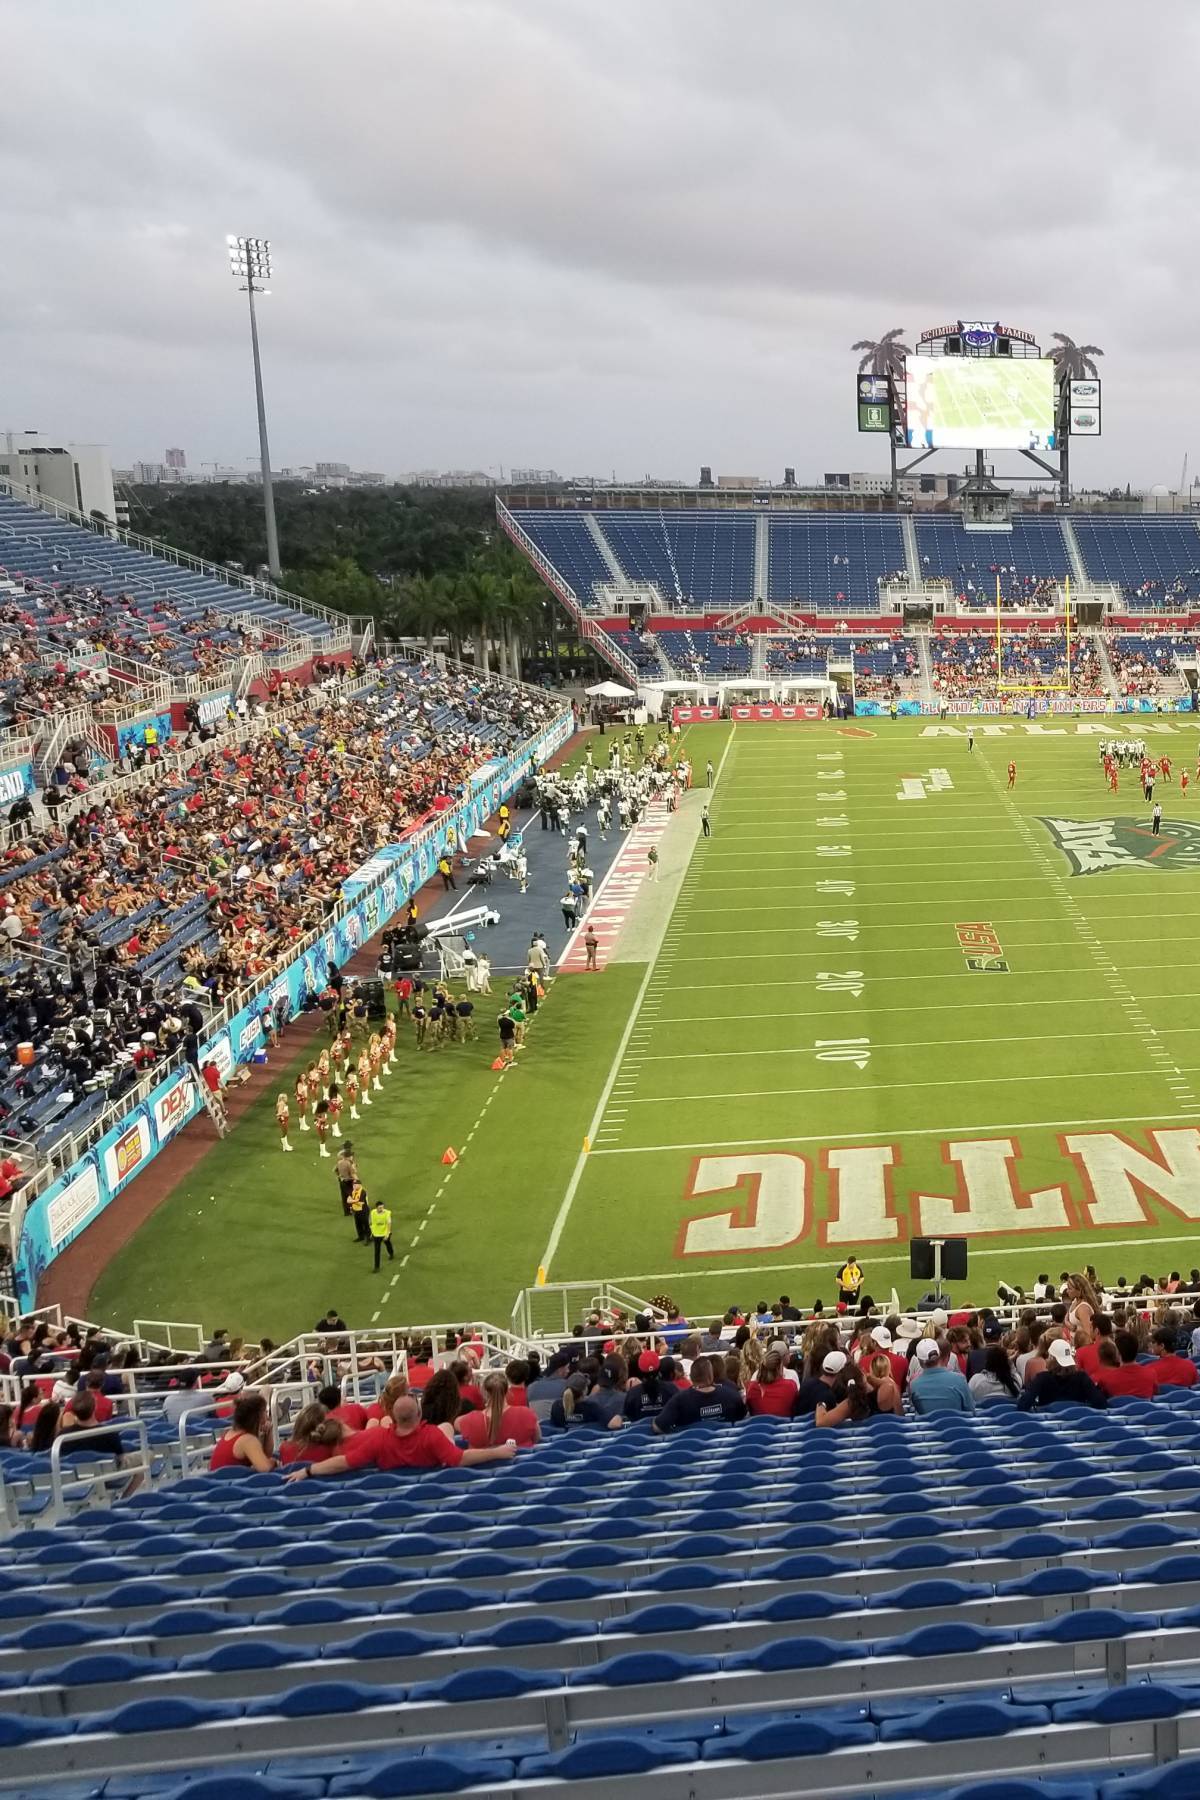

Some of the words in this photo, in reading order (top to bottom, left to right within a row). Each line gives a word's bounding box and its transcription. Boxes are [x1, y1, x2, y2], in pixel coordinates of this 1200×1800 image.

[922, 325, 960, 340] SCHMIDT
[961, 322, 997, 334] FAU
[1002, 327, 1035, 343] FAMILY
[815, 920, 860, 937] 30
[816, 970, 865, 991] 20
[815, 1037, 871, 1061] 10
[161, 1085, 187, 1122] DEX
